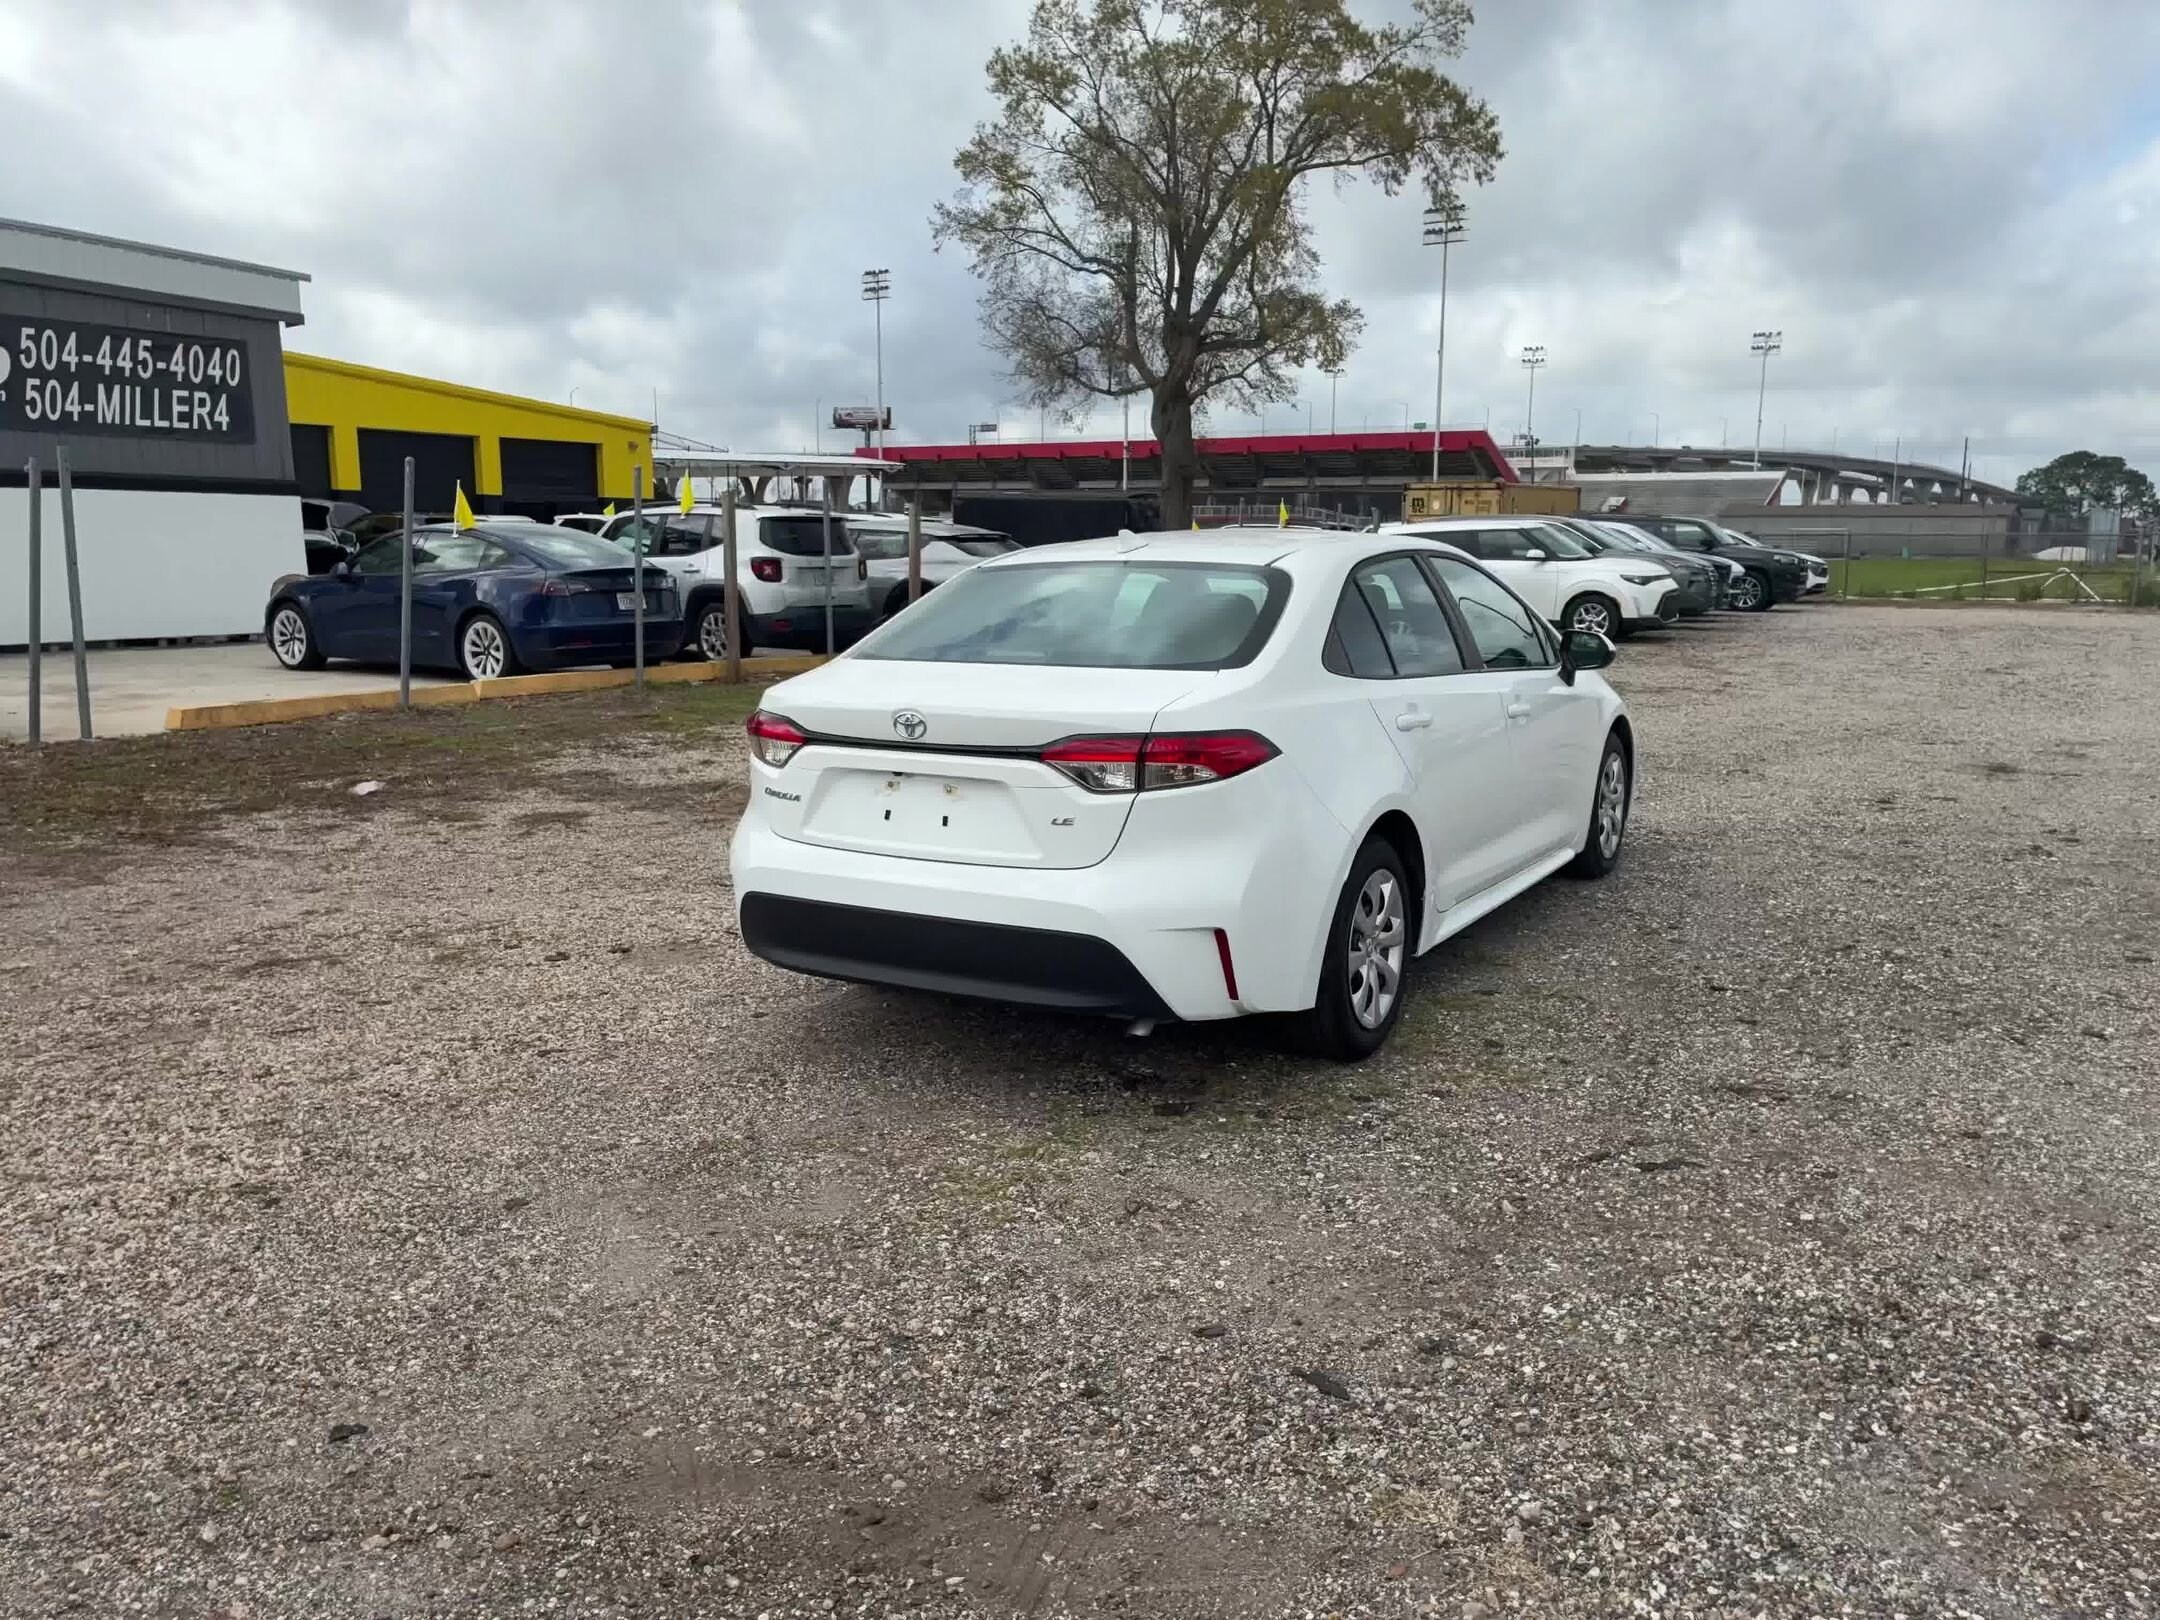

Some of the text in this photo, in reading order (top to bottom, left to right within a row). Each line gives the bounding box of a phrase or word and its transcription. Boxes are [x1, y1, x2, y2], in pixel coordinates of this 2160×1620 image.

[19, 327, 241, 387] 504-445-4040
[25, 378, 230, 431] 504-MILLER4
[1051, 817, 1076, 826] LE
